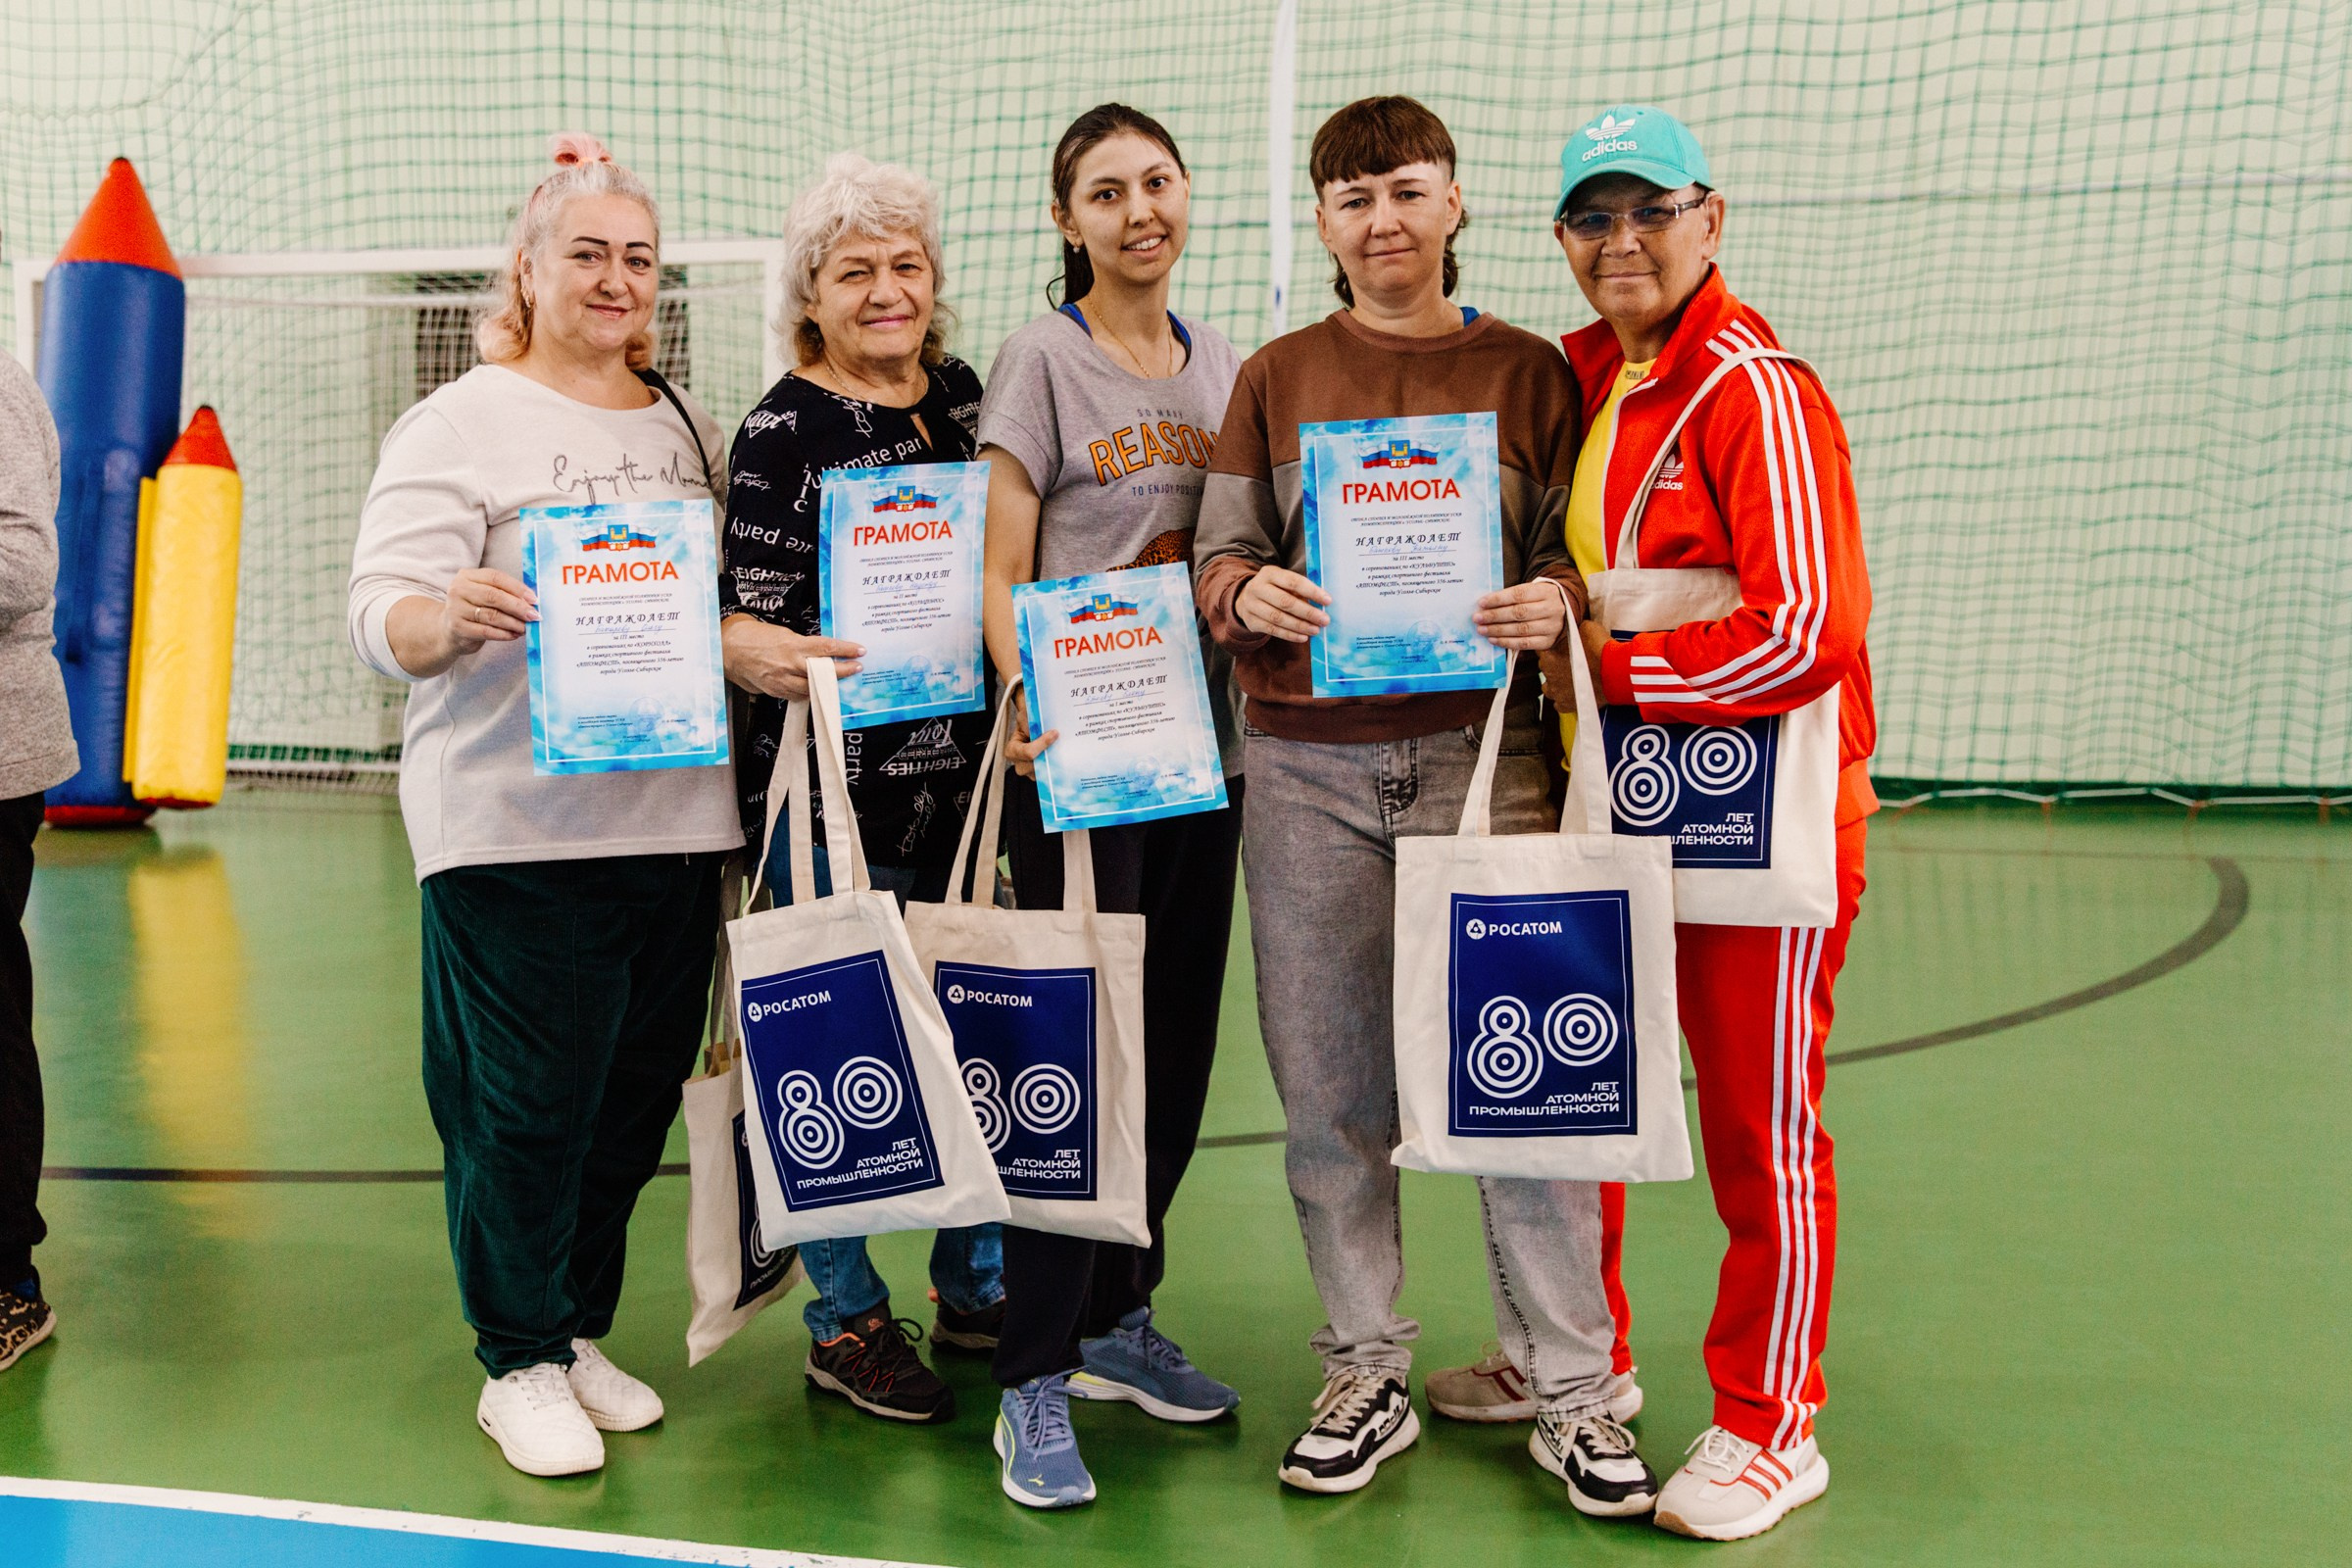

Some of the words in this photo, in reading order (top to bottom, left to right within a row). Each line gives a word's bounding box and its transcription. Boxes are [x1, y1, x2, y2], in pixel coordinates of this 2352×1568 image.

[1582, 139, 1637, 162] adidas
[614, 453, 654, 494] the
[811, 448, 892, 489] umate
[1132, 486, 1144, 496] TO
[1149, 484, 1173, 494] ENJOY
[1342, 478, 1461, 504] ГРАМОТА
[730, 516, 781, 545] party
[853, 519, 954, 546] ГРАМОТА
[1355, 532, 1461, 547] НАГРАЖДАЕТ
[562, 560, 679, 585] ГРАМОТА
[862, 569, 951, 585] НАГРАЖДАЕТ
[576, 612, 680, 625] НАГРАЖДАЕТ
[1054, 626, 1163, 660] ГРАМОТА
[1070, 674, 1168, 697] НАГРАЖДАЕТ
[887, 757, 960, 776] EIGHTIES
[1608, 724, 1757, 826] 80
[1682, 821, 1754, 833] АТОМНОЙ
[1726, 813, 1754, 823] ЛЕТ
[1489, 921, 1562, 936] РОСАТОМ
[762, 991, 831, 1015] РОСАТОМ
[967, 990, 1032, 1006] РОСАТОМ
[1467, 993, 1618, 1099] 80
[1545, 1090, 1619, 1104] АТОМНОЙ
[1592, 1082, 1619, 1092] ЛЕТ
[777, 1056, 903, 1169] 80
[1470, 1103, 1619, 1115] ПРОМЫШЛЕННОСТИ
[892, 1137, 916, 1151] ЛЕТ
[1054, 1149, 1080, 1159] ЛЕТ
[857, 1147, 921, 1169] АТОМНОЙ
[1011, 1155, 1081, 1168] АТОМНОЙ
[797, 1158, 923, 1190] ПРОМЫШЛЕННОСТИ
